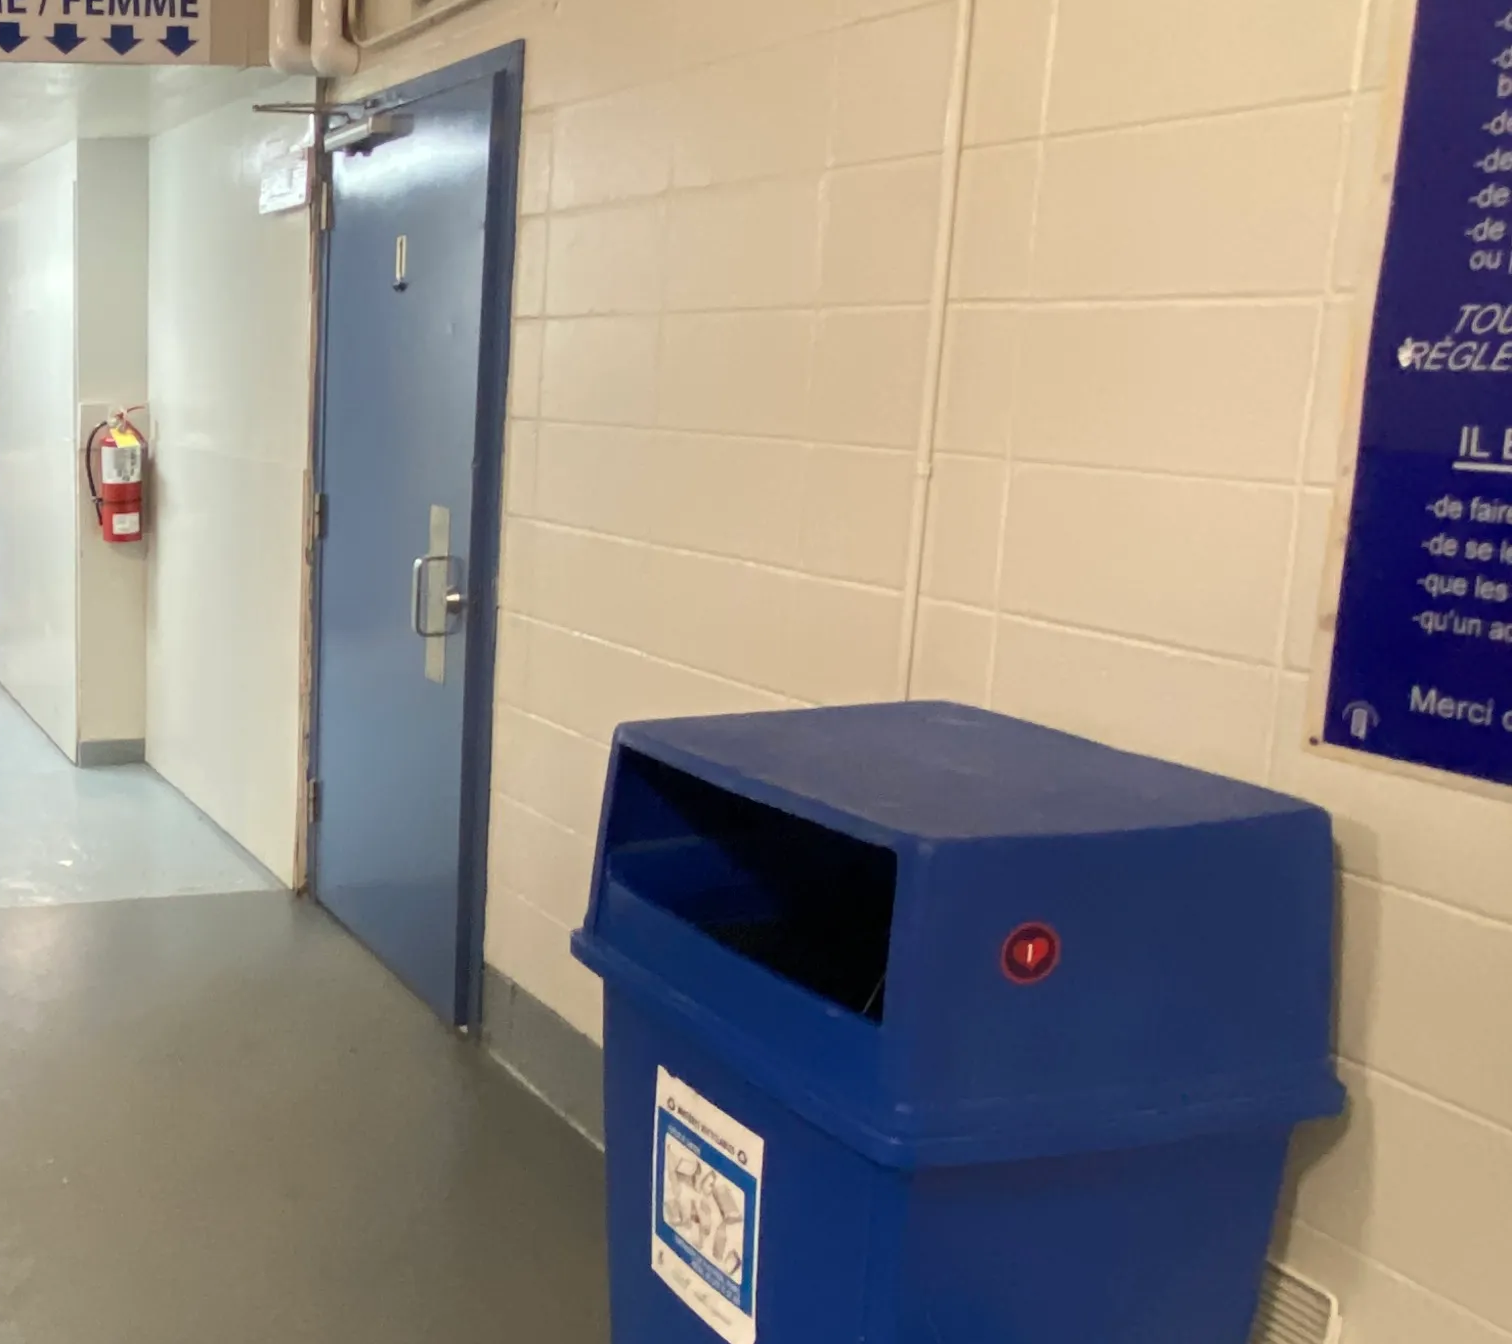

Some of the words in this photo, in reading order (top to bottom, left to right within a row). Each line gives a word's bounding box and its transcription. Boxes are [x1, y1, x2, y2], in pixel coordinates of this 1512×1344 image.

[1470, 250, 1502, 271] ou
[1459, 426, 1491, 458] IL
[1425, 494, 1463, 519] -de
[1421, 532, 1459, 557] -de
[1465, 541, 1493, 561] se
[1416, 573, 1468, 598] -que
[1474, 576, 1508, 602] les
[1409, 685, 1496, 726] Merci
